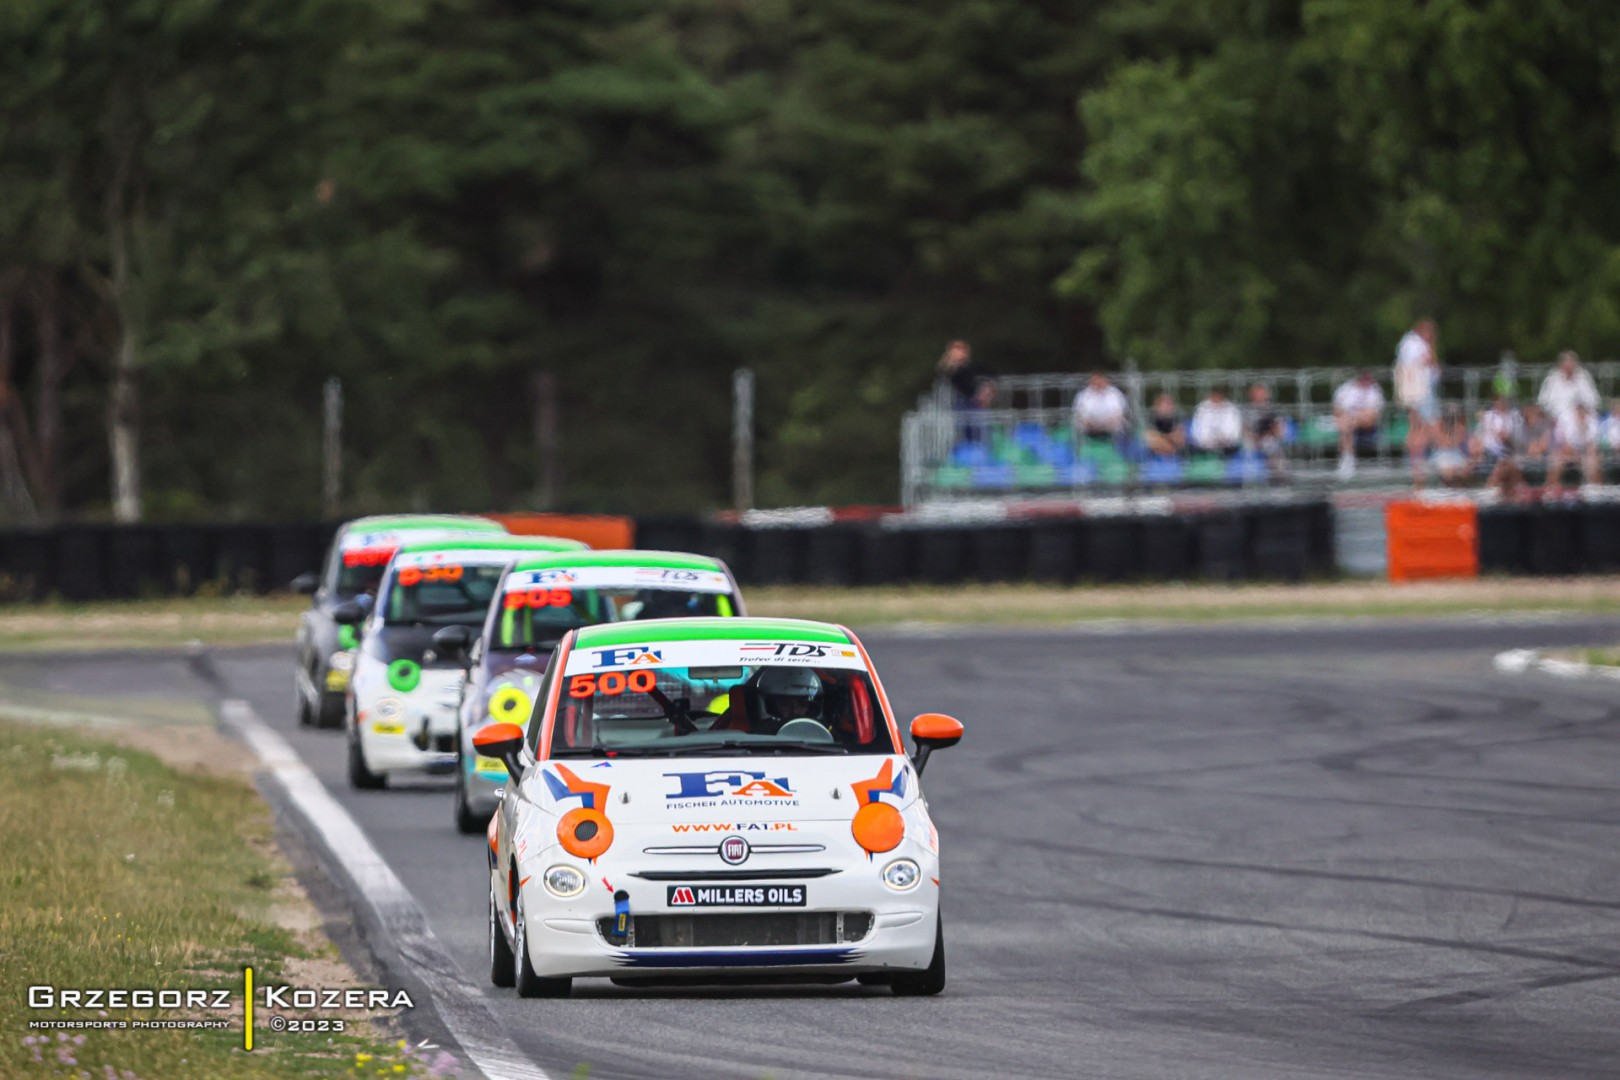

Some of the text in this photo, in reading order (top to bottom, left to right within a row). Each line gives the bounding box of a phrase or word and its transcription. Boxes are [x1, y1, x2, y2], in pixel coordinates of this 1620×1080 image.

[773, 642, 832, 657] TDS
[568, 669, 657, 698] 500
[666, 799, 800, 810] FISCHER AUTOMOTIVE
[672, 822, 798, 832] WWW.FA1.PL
[727, 843, 744, 857] FIAT
[698, 888, 803, 904] MILLERS OILS
